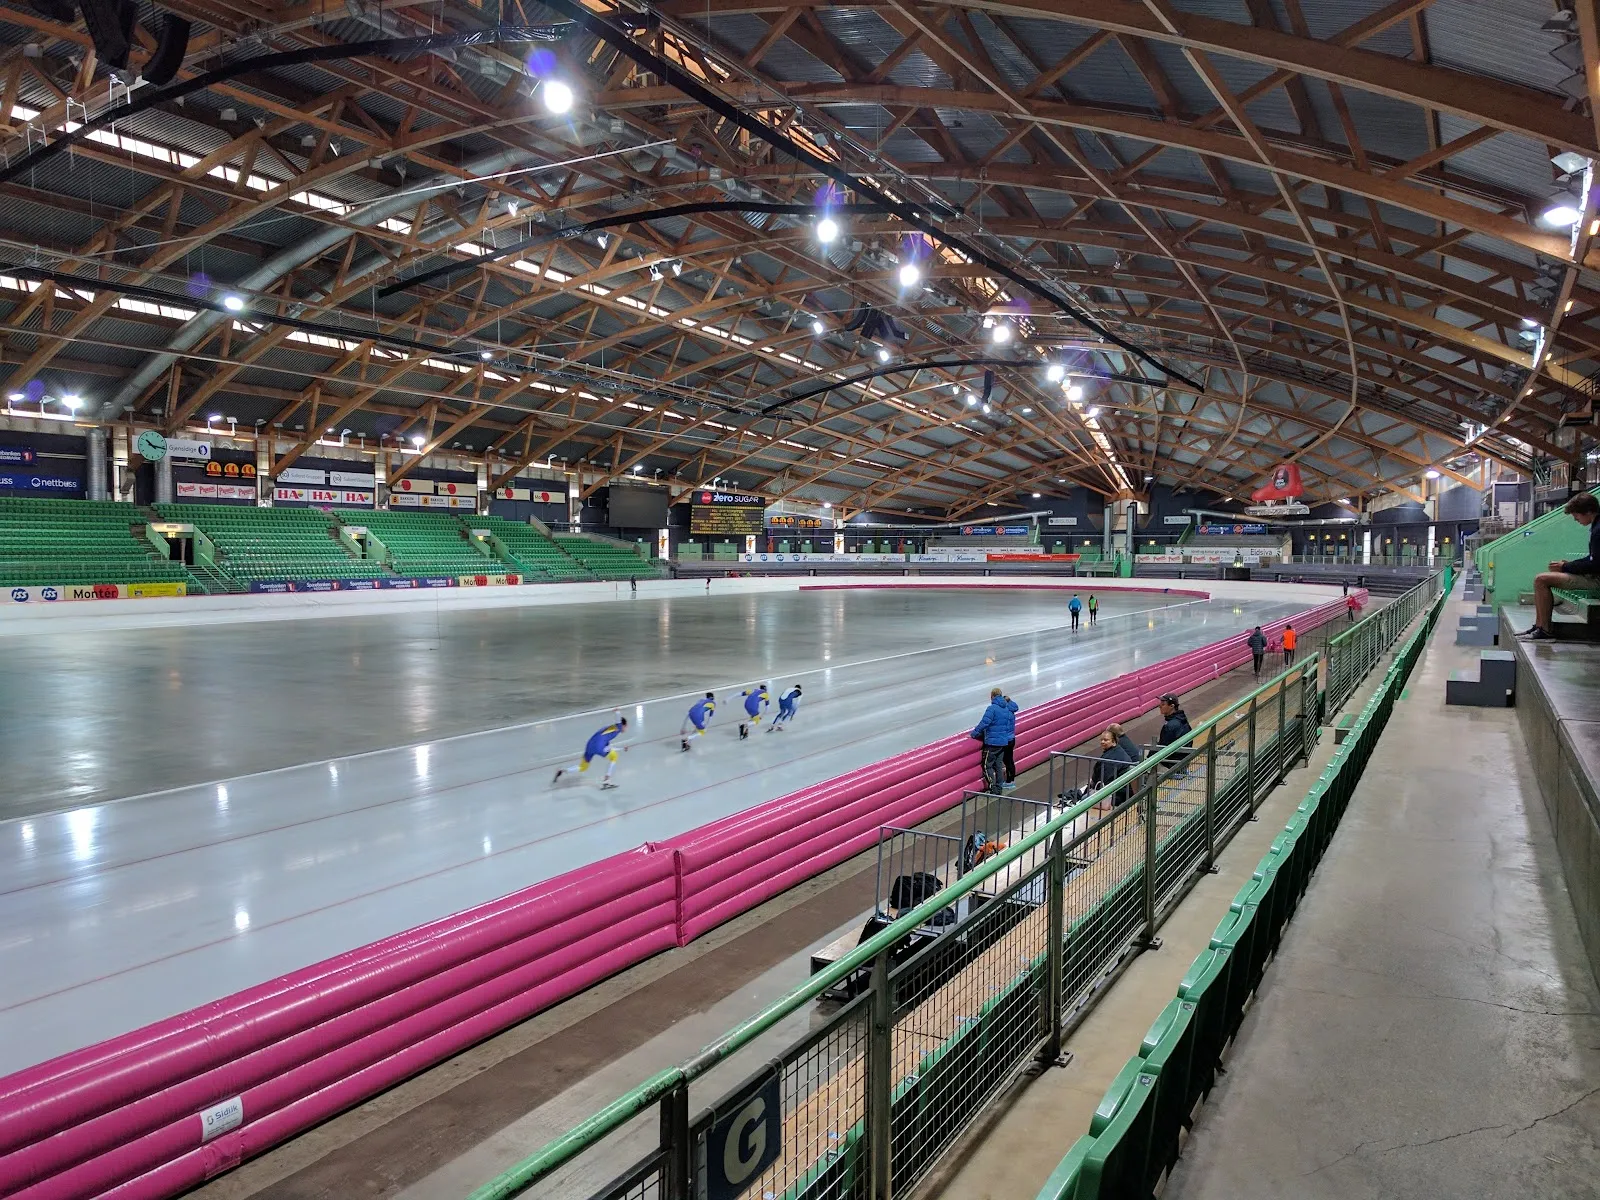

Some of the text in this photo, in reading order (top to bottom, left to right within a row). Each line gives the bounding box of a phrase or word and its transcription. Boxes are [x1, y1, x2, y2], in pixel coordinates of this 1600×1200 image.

[168, 444, 197, 453] Gjensidige
[41, 479, 77, 488] nettbuss
[277, 489, 300, 499] HA
[312, 491, 333, 501] HA
[346, 493, 365, 502] HA
[713, 494, 734, 502] zero
[734, 495, 759, 503] SUGAR
[1250, 548, 1273, 556] Eidsiva
[73, 587, 116, 599] Montér
[723, 1096, 767, 1185] G
